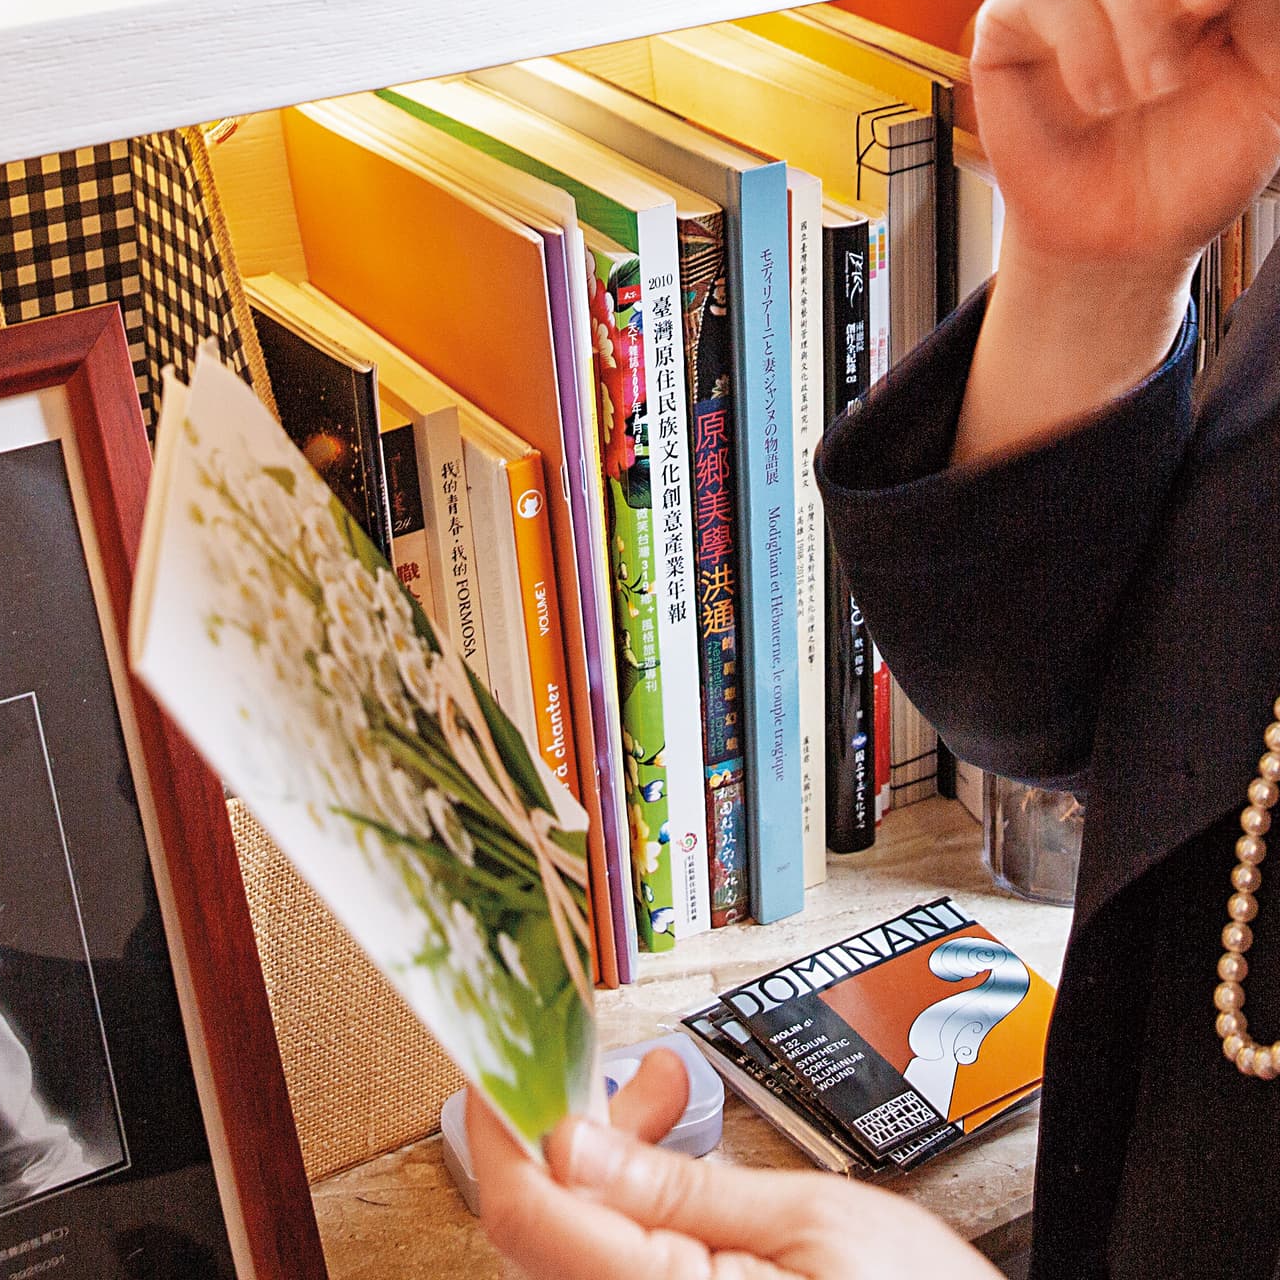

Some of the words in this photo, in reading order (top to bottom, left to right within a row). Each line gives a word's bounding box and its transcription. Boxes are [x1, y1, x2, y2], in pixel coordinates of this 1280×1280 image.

[648, 274, 674, 290] 2010
[759, 248, 779, 486] モディリアーニと妻ジャンヌの物語展
[652, 295, 688, 624] 臺灣原住民族文化創意產業年報
[766, 506, 783, 579] Modigliani
[770, 581, 782, 593] et
[456, 578, 478, 659] FORMOSA
[531, 590, 550, 637] VOLUME
[773, 671, 785, 683] le
[545, 682, 567, 759] chanter
[769, 685, 786, 726] couple
[769, 727, 786, 782] tragique
[730, 900, 970, 1017] DOMINANT
[770, 1023, 803, 1045] VIOLIN
[780, 1039, 801, 1053] 132
[786, 1035, 829, 1060] MEDIUM
[796, 1038, 850, 1069] SYNTHETIC
[810, 1052, 865, 1084] ALUMINUM
[816, 1067, 856, 1091] WOUND
[871, 1109, 935, 1145] VIENNA
